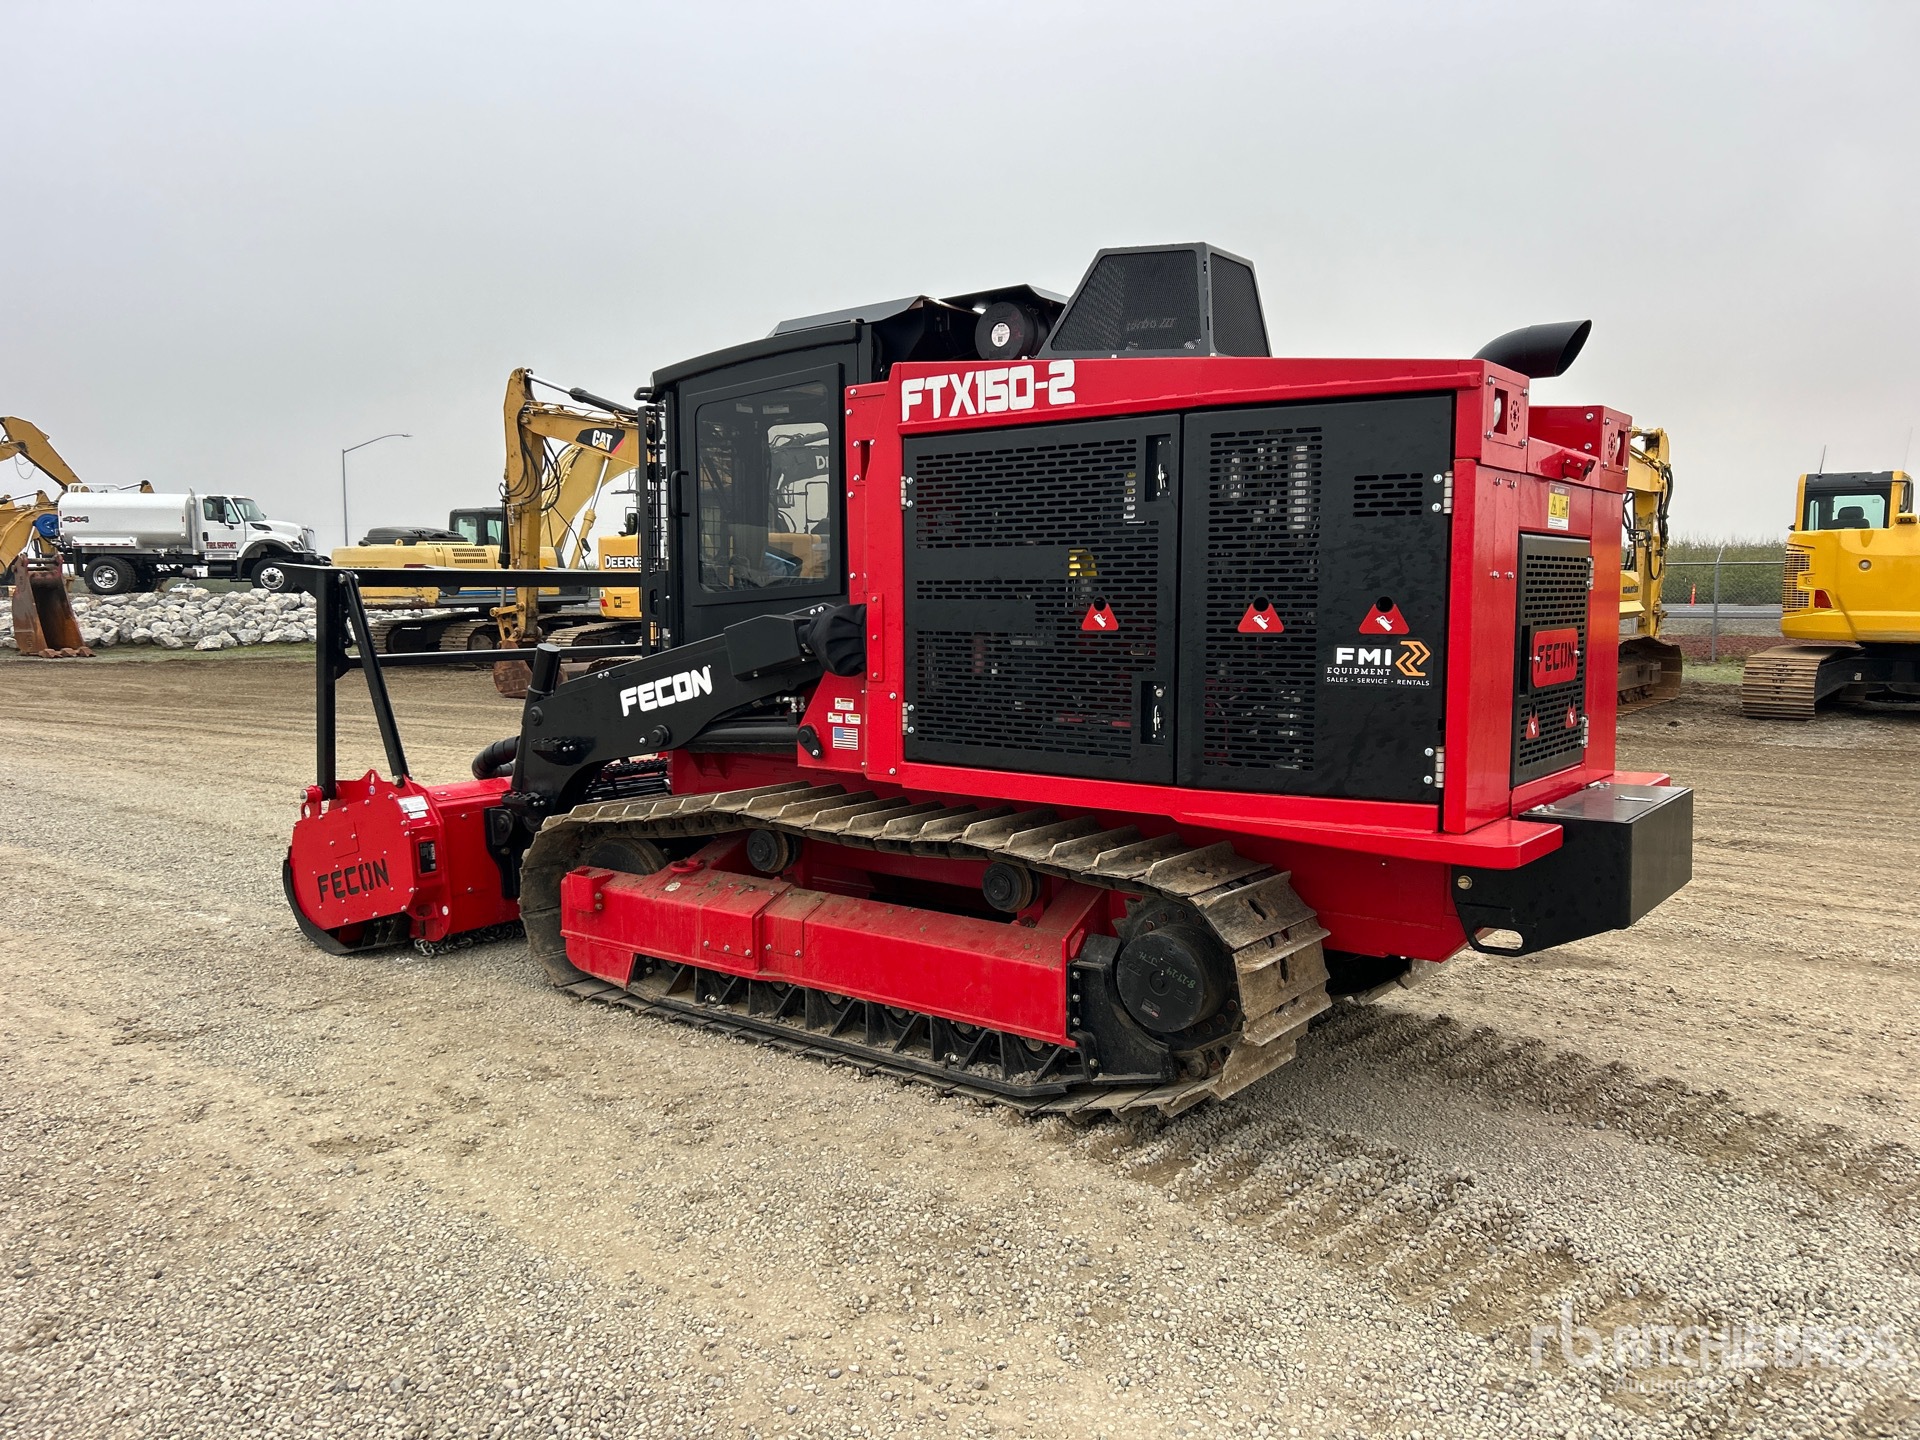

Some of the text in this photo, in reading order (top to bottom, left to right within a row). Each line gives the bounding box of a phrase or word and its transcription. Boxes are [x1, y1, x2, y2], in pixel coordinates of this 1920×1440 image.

[901, 359, 1076, 422] FTX150-2
[592, 429, 613, 451] CAT
[604, 554, 642, 569] DEERE
[1336, 647, 1392, 666] FMI
[1537, 641, 1576, 673] FECON
[1326, 667, 1392, 676] EQUIPMENT
[1356, 677, 1388, 685] SERVICE
[1396, 679, 1430, 687] RENTALS
[620, 665, 713, 718] FECON
[317, 857, 390, 903] FECON
